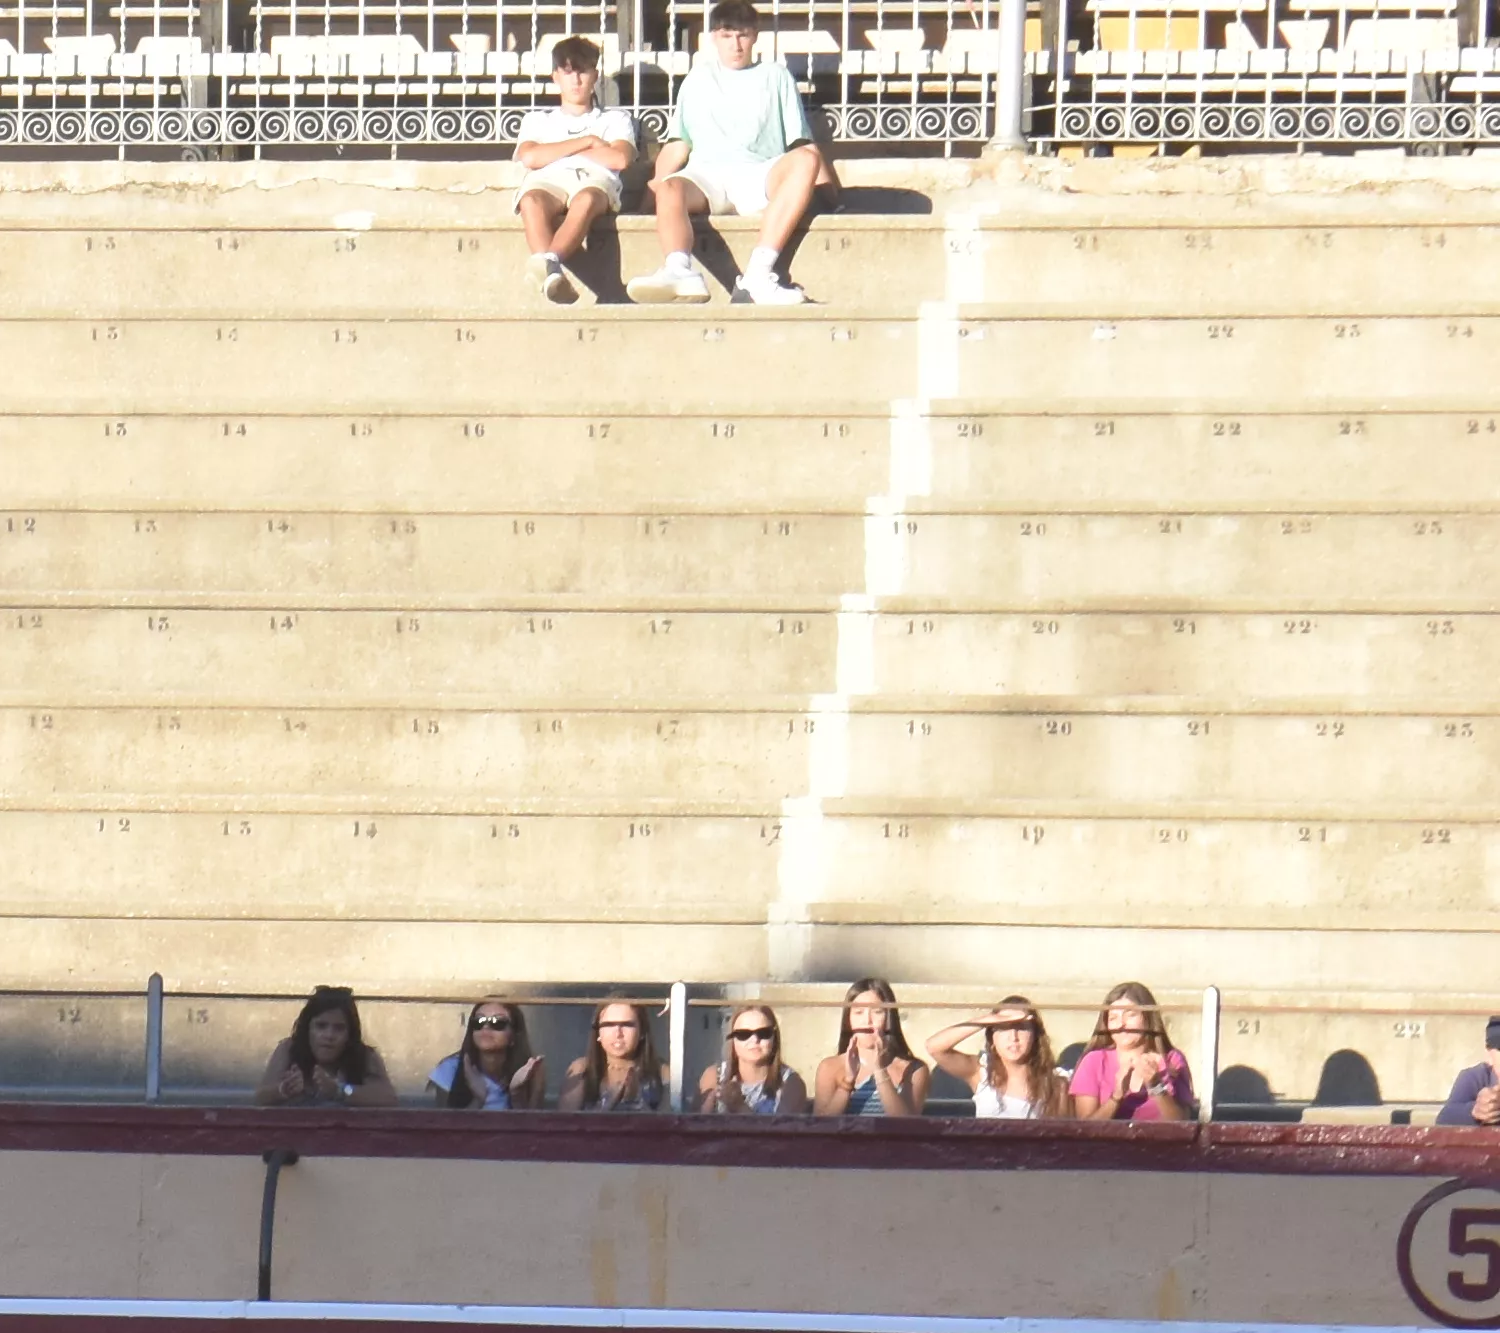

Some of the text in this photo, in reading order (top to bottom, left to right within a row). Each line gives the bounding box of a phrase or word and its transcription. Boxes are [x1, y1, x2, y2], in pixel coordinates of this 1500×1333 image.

[456, 328, 476, 342] 16
[224, 423, 246, 436] 14
[464, 424, 484, 437] 16
[713, 423, 735, 437] 18
[1095, 421, 1114, 436] 21
[1213, 423, 1241, 436] 22
[1468, 420, 1496, 434] 24
[8, 518, 35, 533] 12
[1020, 522, 1046, 536] 20
[271, 616, 293, 630] 14
[651, 620, 672, 634] 17
[778, 619, 803, 634] 18
[908, 621, 934, 634] 19
[1032, 620, 1060, 634] 20
[1173, 618, 1196, 634] 21
[1284, 620, 1311, 634] 22
[909, 720, 931, 735] 19
[1047, 721, 1071, 735] 20
[1187, 721, 1209, 736] 21
[1316, 722, 1344, 738] 22
[99, 818, 130, 832] 12
[354, 821, 377, 838] 14
[629, 823, 650, 838] 16
[1023, 826, 1044, 844] 19
[1298, 827, 1326, 842] 21
[1422, 829, 1450, 844] 22
[58, 1008, 81, 1026] 12
[1237, 1019, 1260, 1034] 21
[1447, 1208, 1500, 1302] 5
